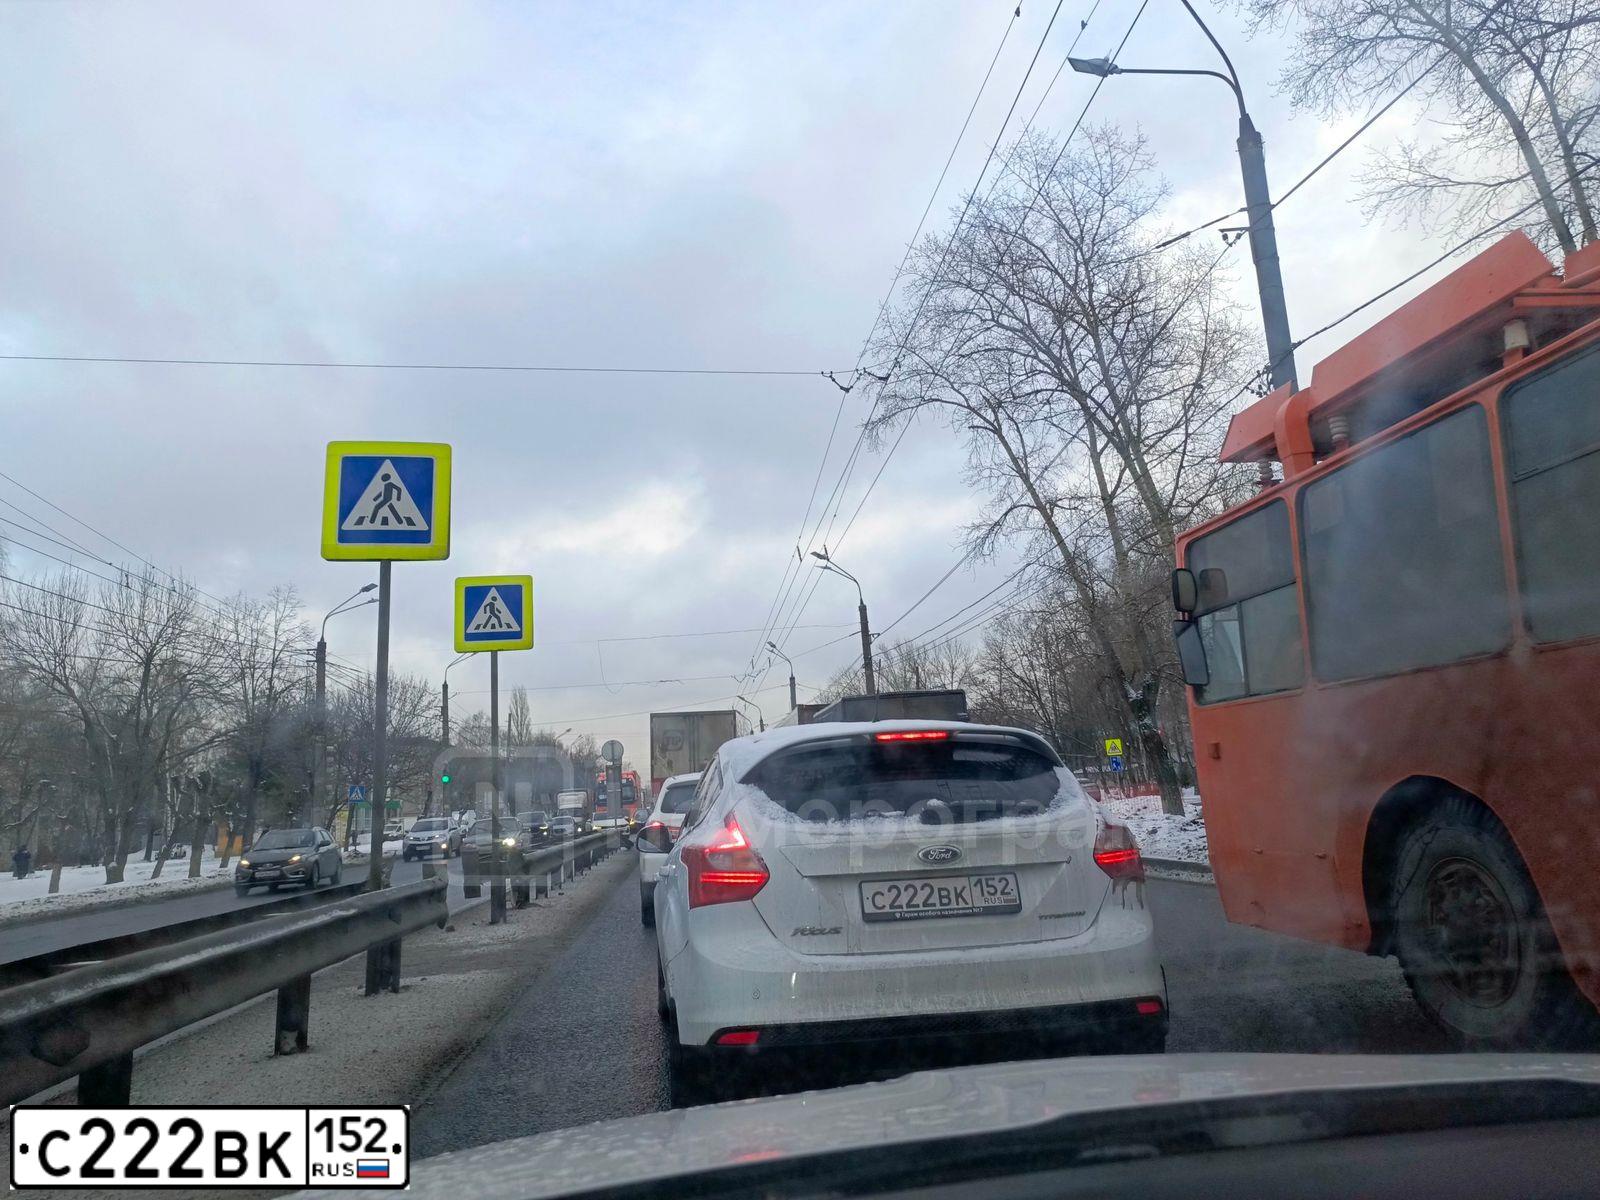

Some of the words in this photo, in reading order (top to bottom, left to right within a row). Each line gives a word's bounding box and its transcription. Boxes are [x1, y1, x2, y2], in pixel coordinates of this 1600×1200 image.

[928, 849, 952, 860] Ford
[871, 882, 969, 910] С222ВК
[973, 876, 1011, 898] 152
[983, 896, 1003, 905] RUS
